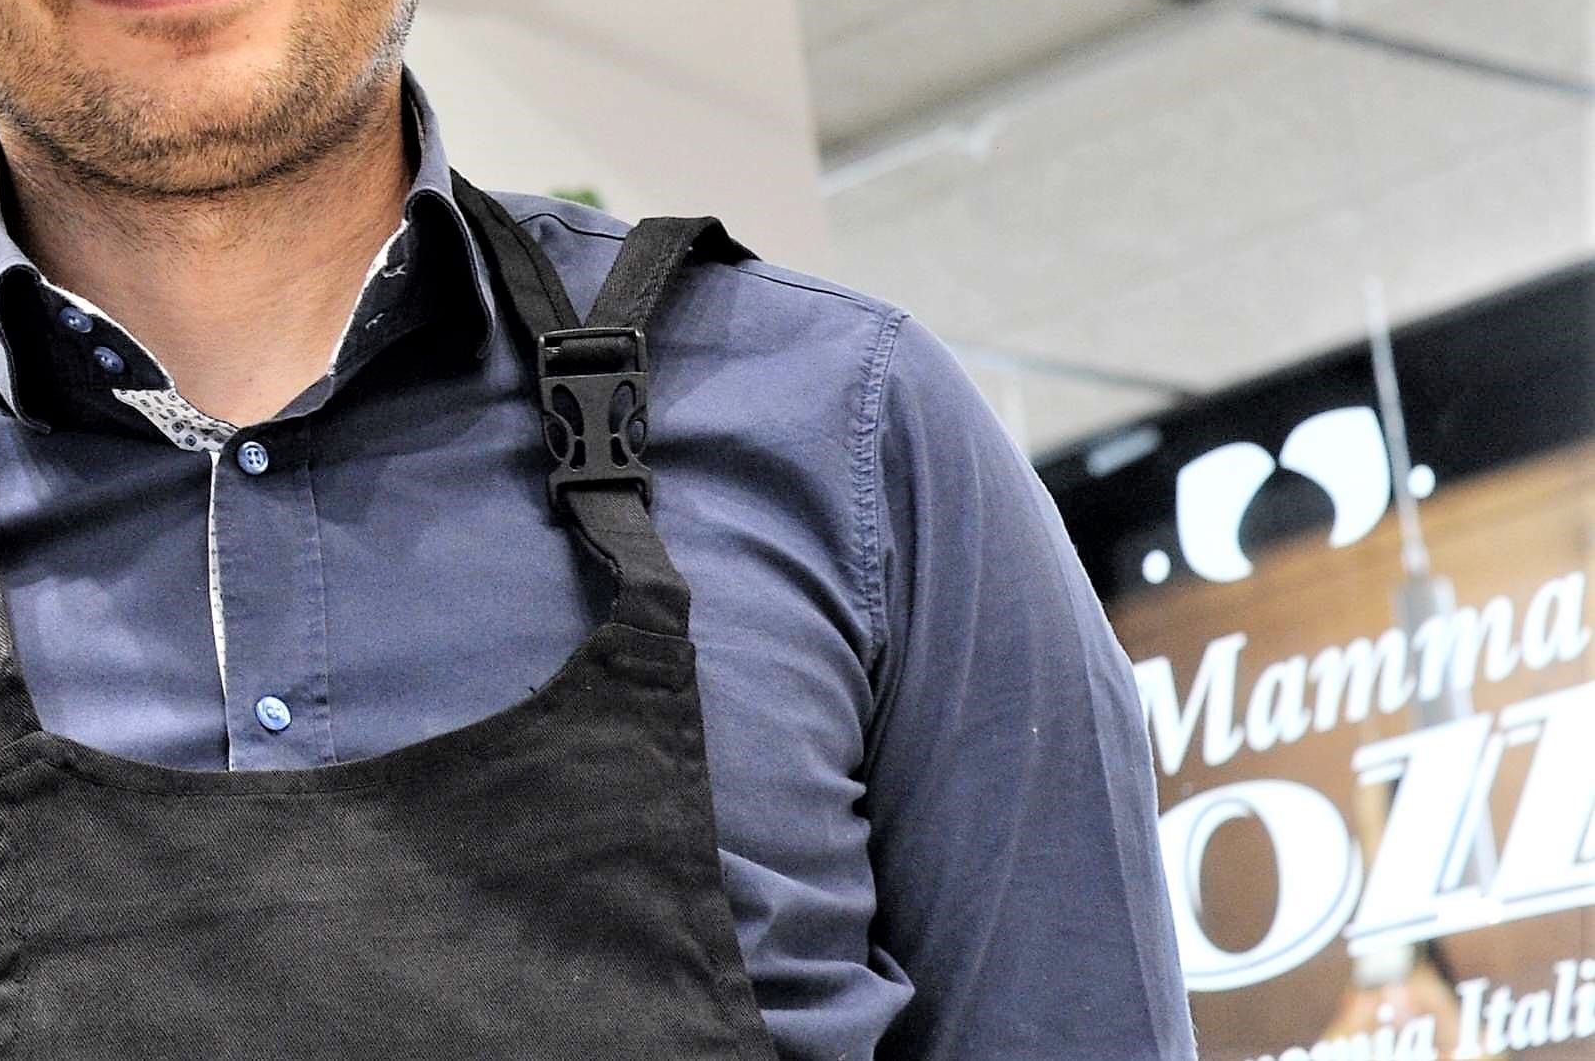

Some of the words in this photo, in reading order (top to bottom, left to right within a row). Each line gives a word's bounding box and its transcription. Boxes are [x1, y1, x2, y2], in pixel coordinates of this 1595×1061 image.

[1132, 573, 1590, 776] Mamma
[1157, 683, 1595, 991] OZZ
[1457, 960, 1595, 1059] Itali
